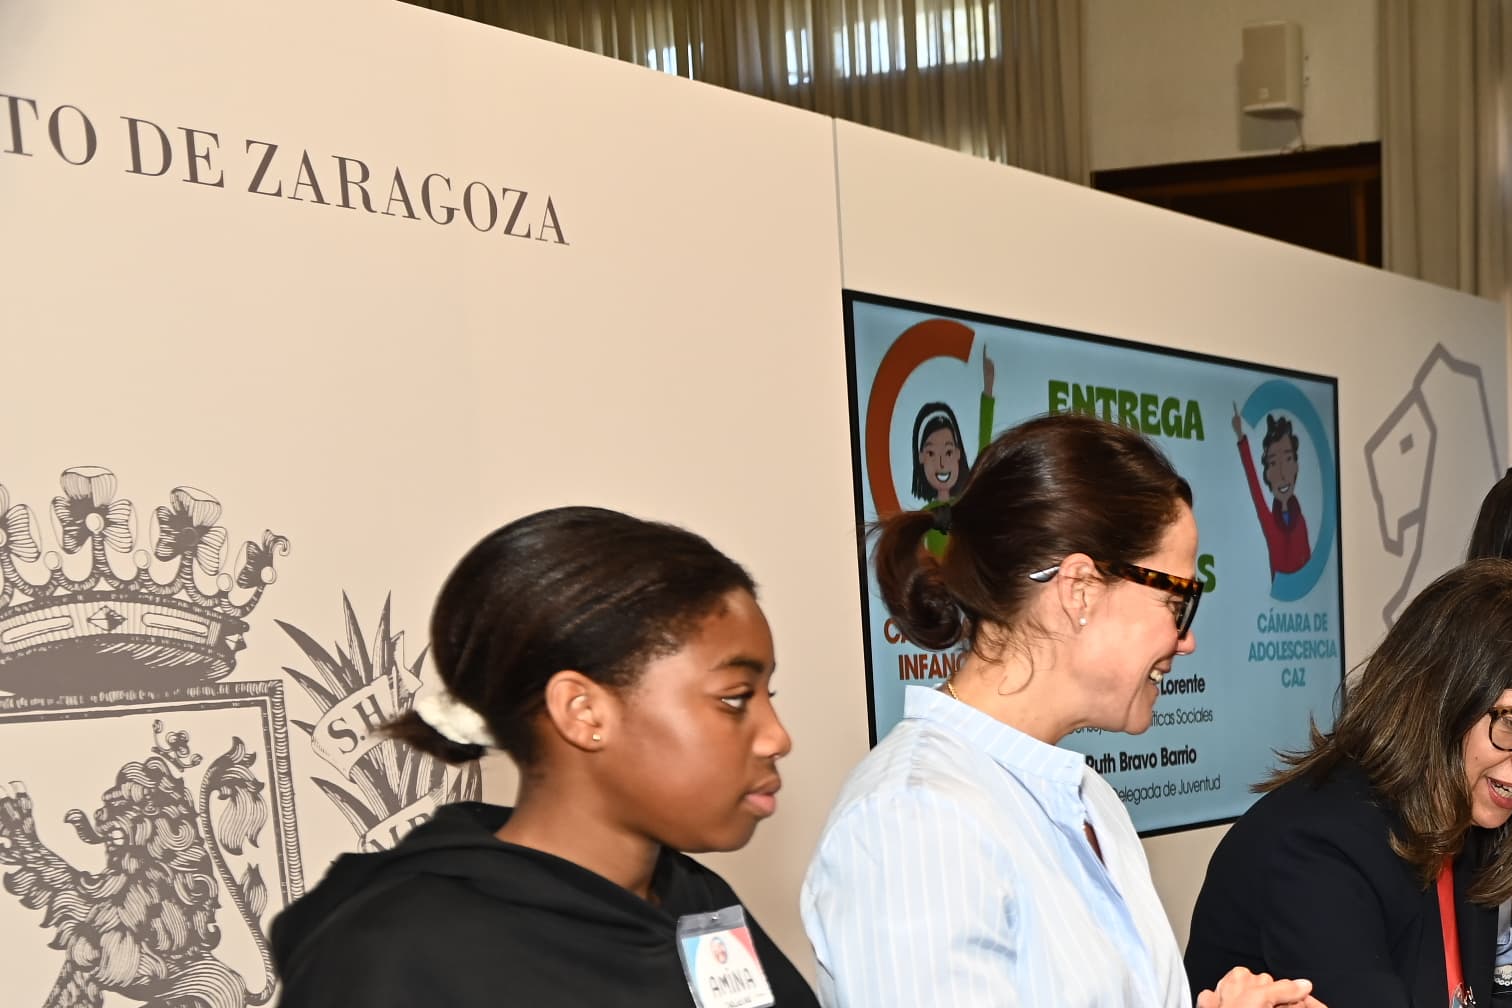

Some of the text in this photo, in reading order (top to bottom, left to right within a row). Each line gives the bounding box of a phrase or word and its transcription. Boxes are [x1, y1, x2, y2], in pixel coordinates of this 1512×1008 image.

[0, 95, 570, 246] TO DE ZARAGOZA
[1048, 380, 1205, 441] ENTREGA
[1257, 607, 1328, 633] CÁMARA DE
[1248, 639, 1338, 662] ADOLESCENCIA
[1160, 673, 1205, 695] Lorente
[1281, 667, 1306, 688] CAZ
[1176, 706, 1213, 726] Sociales
[1119, 750, 1157, 772] Bravo
[1160, 745, 1197, 768] Barrio
[1113, 774, 1221, 805] elegada de Juventud
